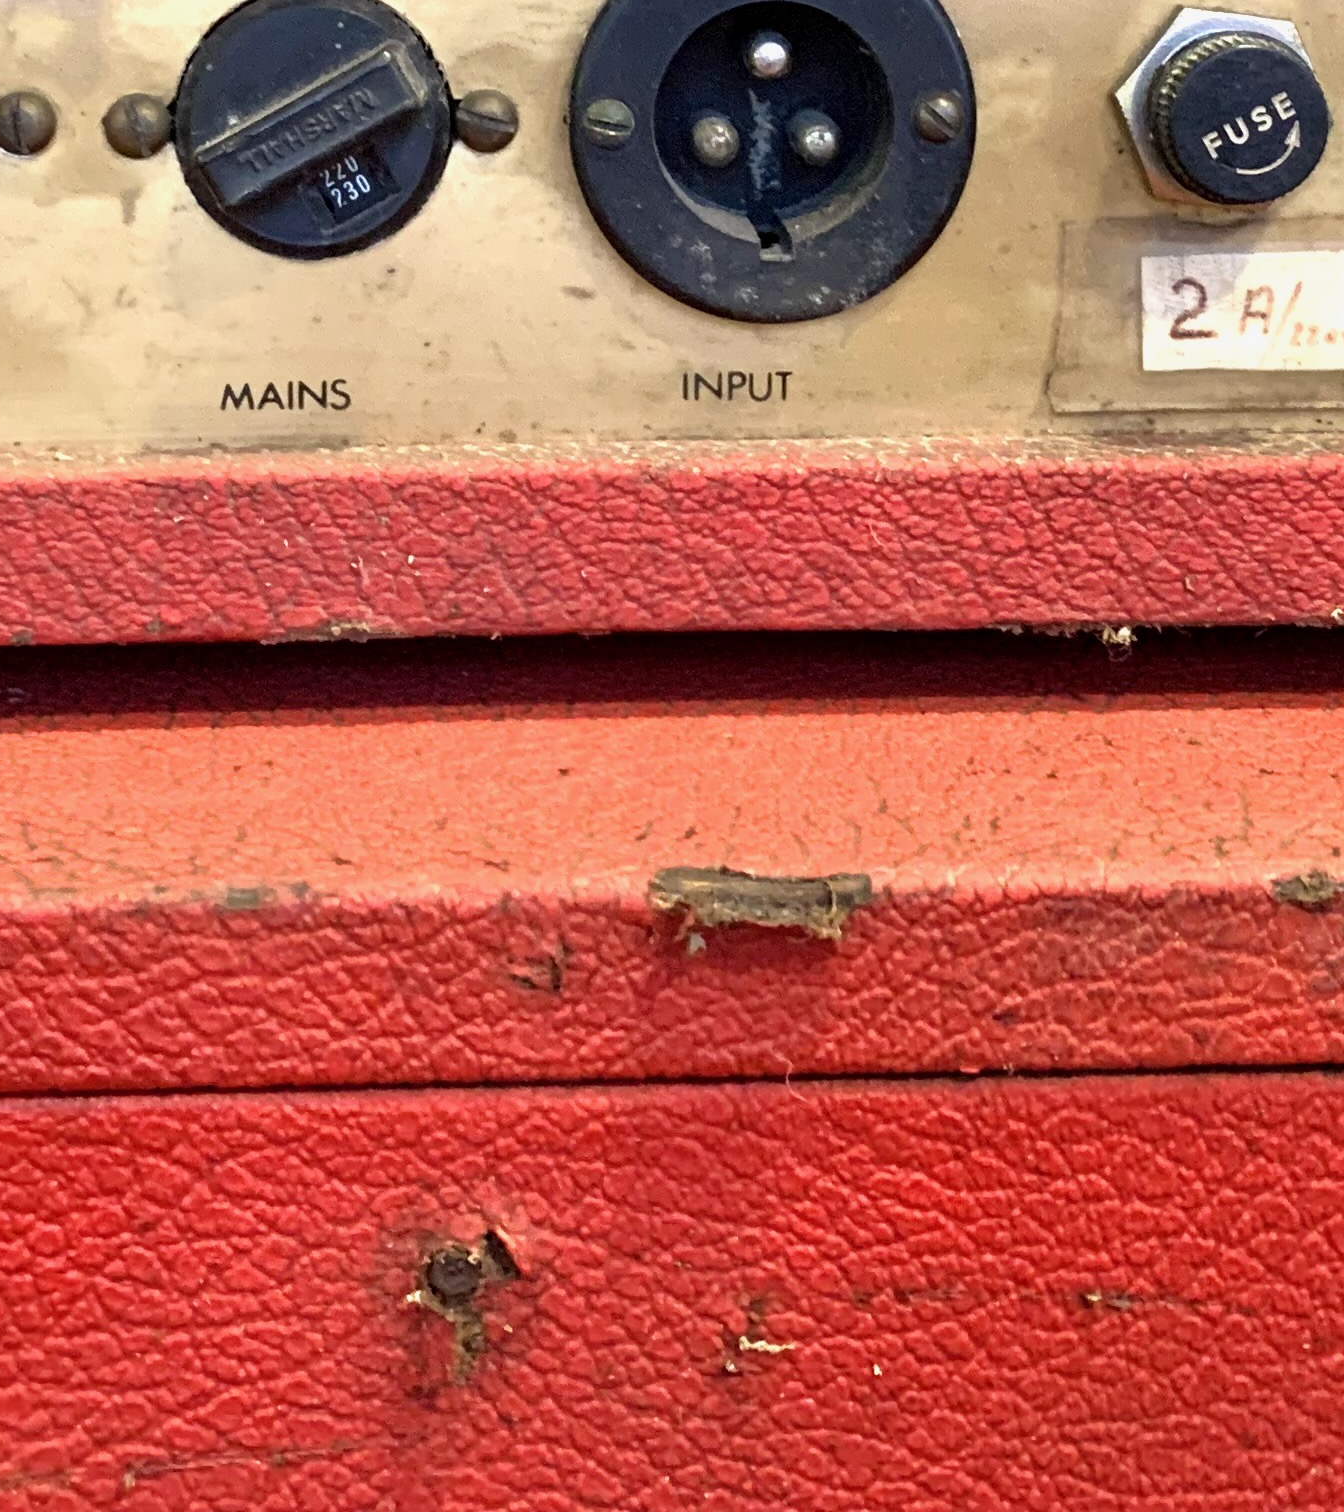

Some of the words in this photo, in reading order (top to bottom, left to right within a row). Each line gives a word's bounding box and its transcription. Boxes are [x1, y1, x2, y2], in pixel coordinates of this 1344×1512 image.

[1201, 91, 1296, 160] FUSE
[1169, 276, 1219, 341] 2
[219, 377, 352, 412] MAINS
[681, 369, 794, 404] INPUT
